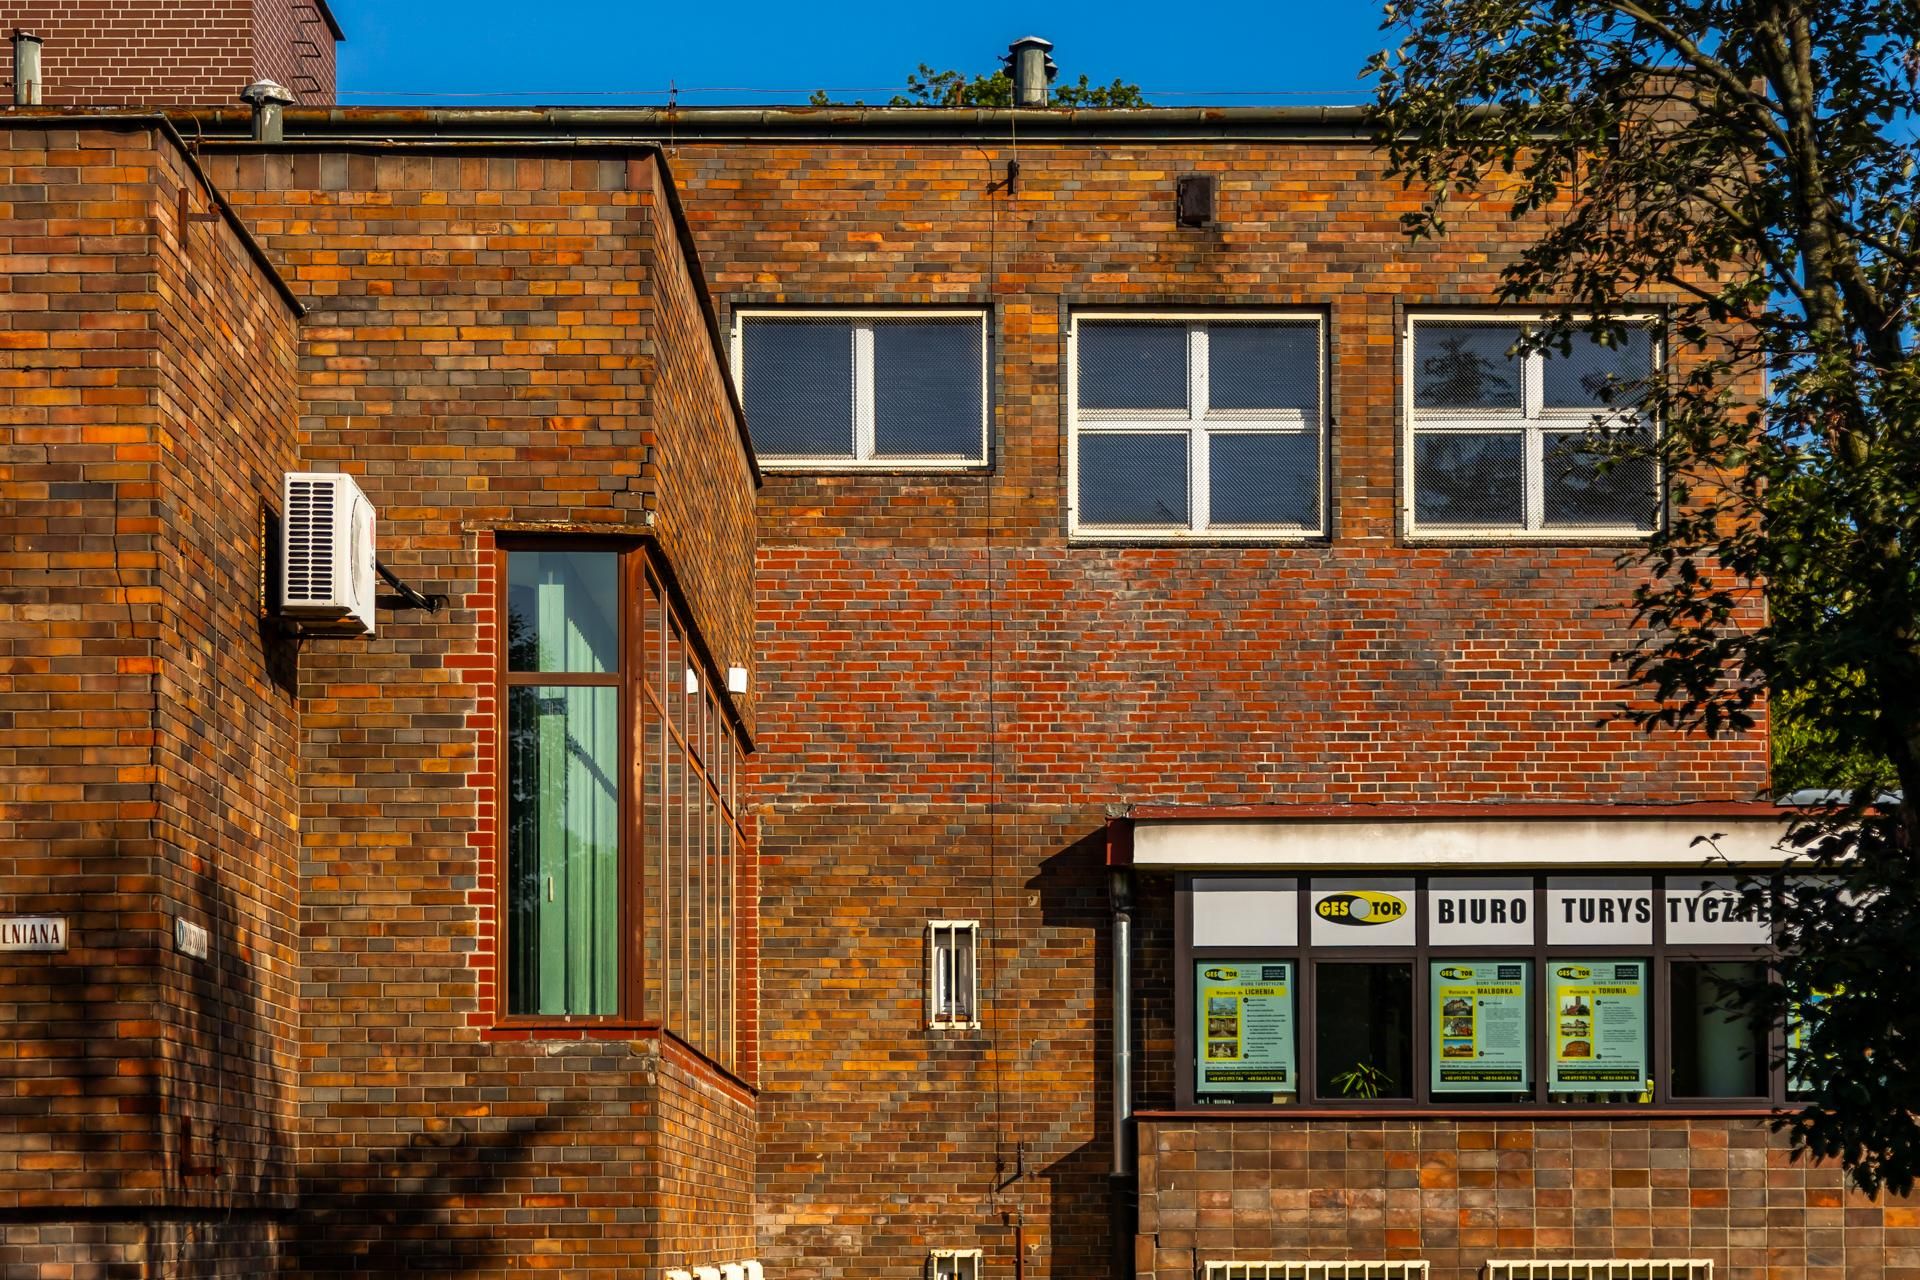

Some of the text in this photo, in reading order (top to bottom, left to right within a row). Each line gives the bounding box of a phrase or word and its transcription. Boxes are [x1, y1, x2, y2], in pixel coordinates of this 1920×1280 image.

[1318, 901, 1402, 916] GES TOR
[1438, 898, 1527, 923] BIURO
[2, 924, 60, 944] LNIANA
